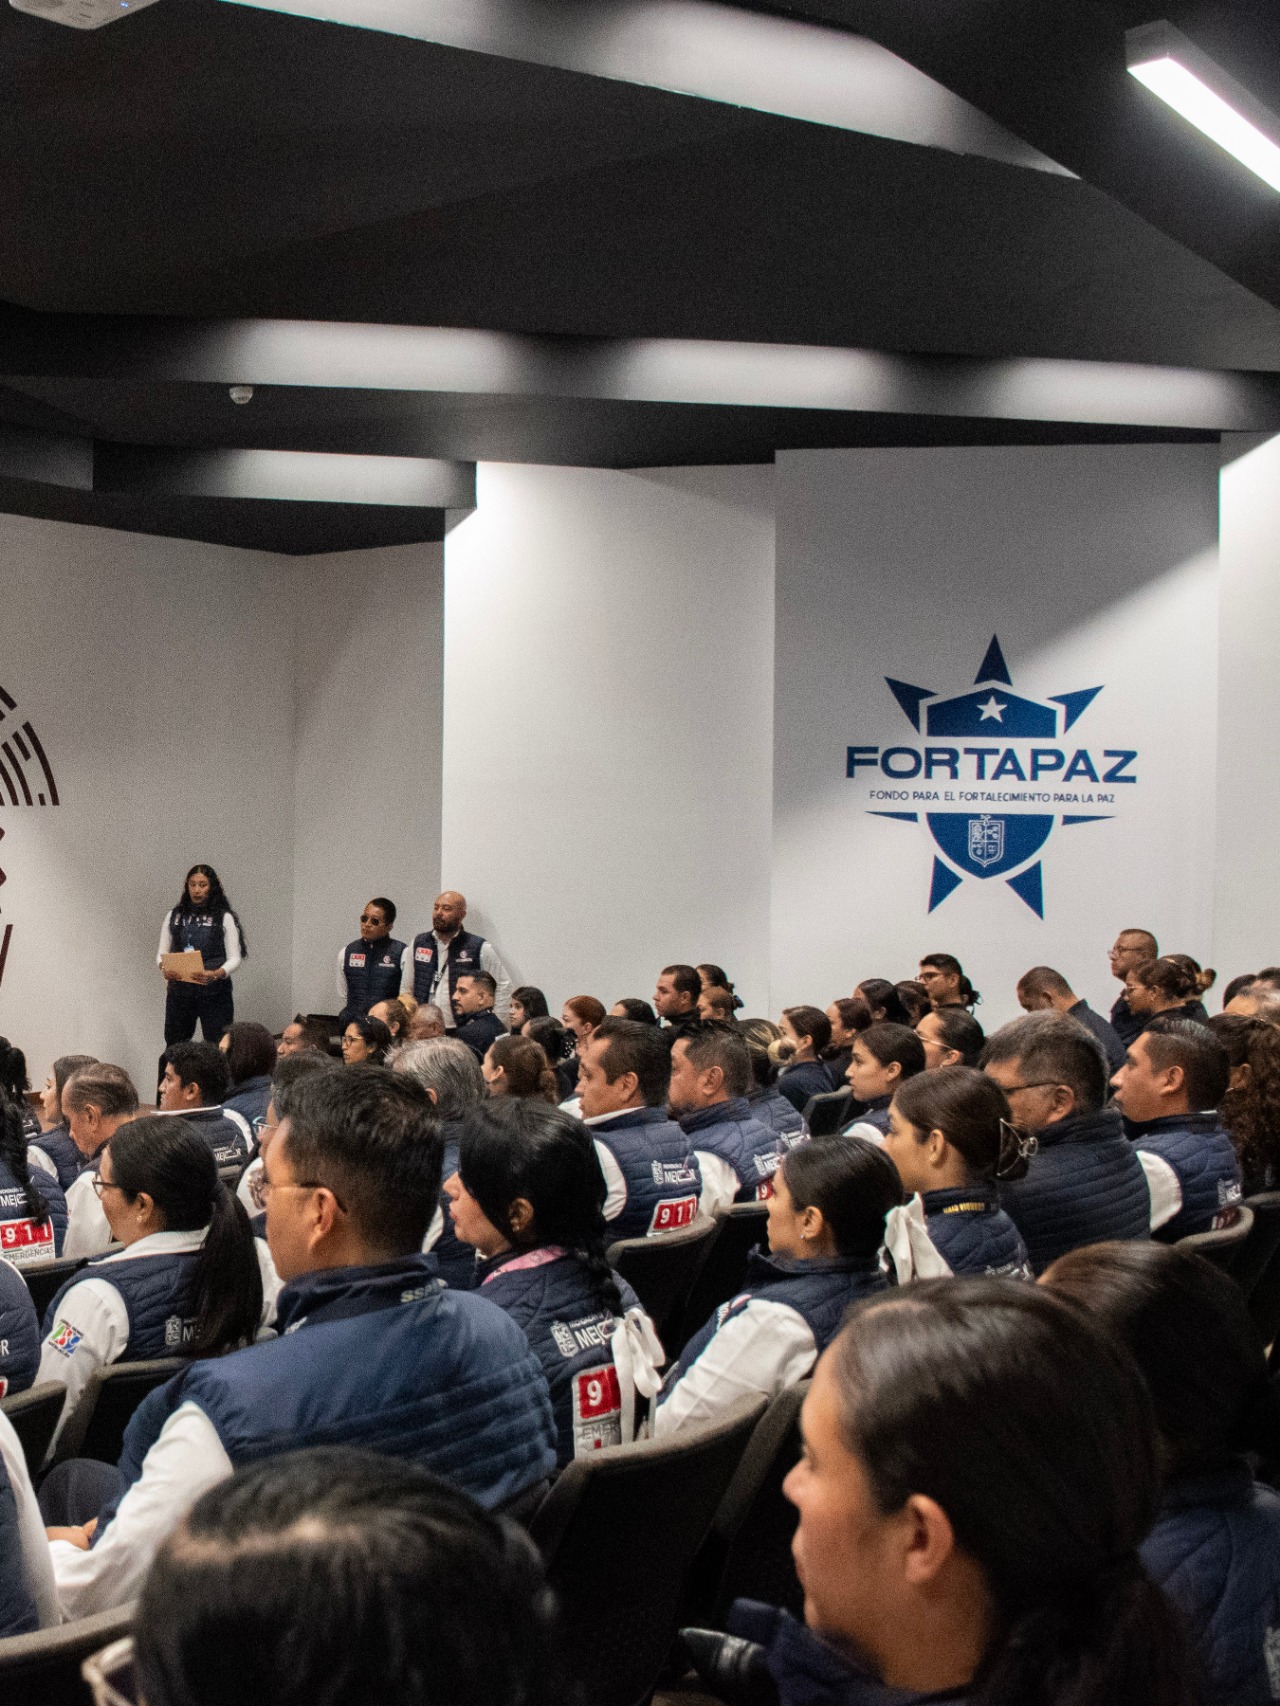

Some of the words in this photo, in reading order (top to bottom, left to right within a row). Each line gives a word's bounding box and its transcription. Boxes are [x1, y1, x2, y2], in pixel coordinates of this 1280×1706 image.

[845, 745, 1139, 784] FORTAPAZ
[869, 790, 910, 801] FONDO
[912, 791, 940, 801] PARA
[944, 791, 956, 801] EL
[959, 791, 1051, 803] FORTALECIMIENTO
[1053, 792, 1079, 803] PARA
[1081, 792, 1094, 803] LA
[1097, 793, 1115, 804] PAZ
[660, 1202, 694, 1224] 911
[5, 1222, 49, 1243] 911
